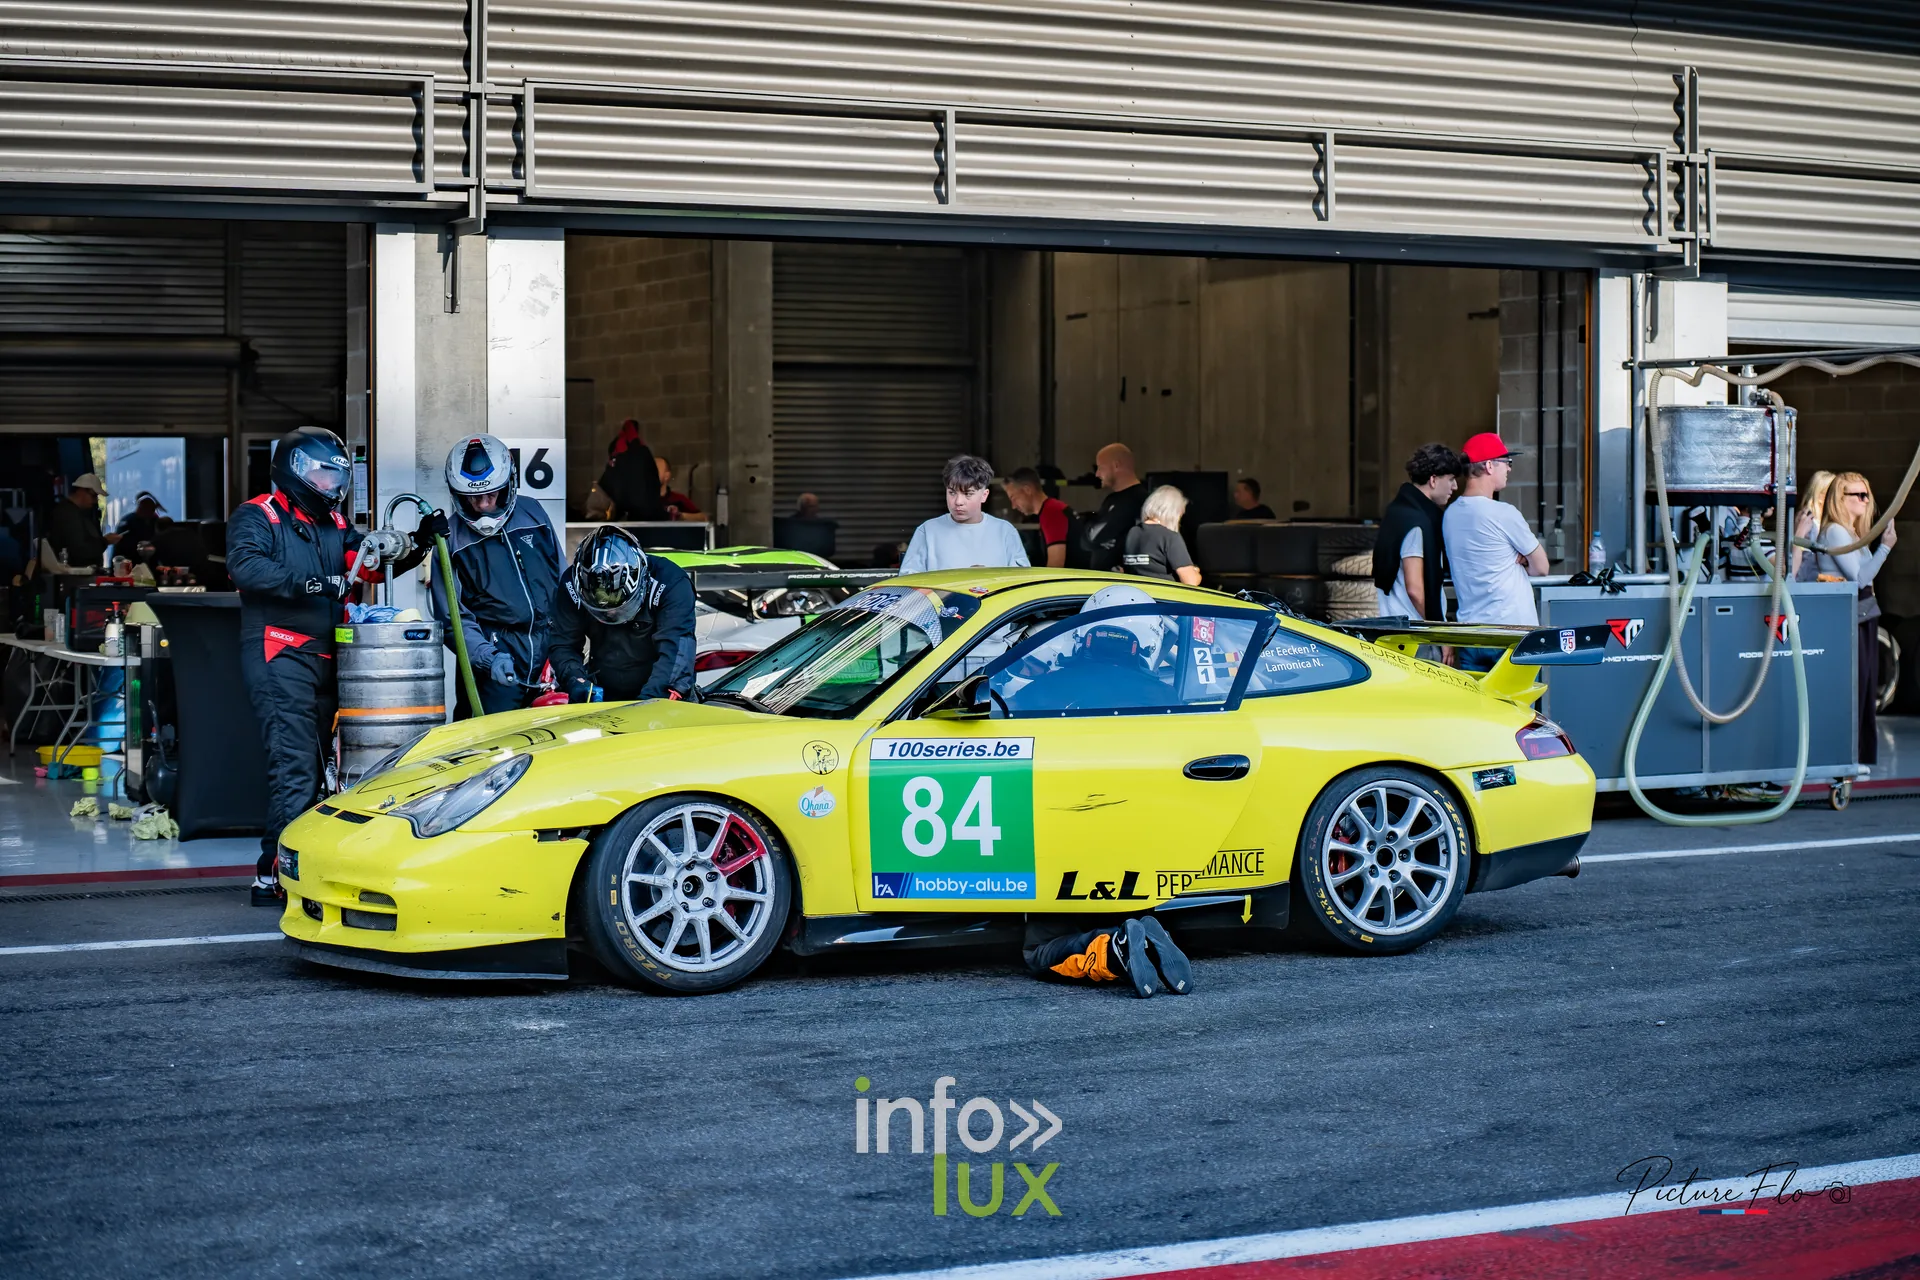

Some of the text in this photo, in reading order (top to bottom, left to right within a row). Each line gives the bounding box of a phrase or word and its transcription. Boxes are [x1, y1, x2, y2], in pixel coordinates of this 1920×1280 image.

[269, 630, 294, 643] sparco
[1197, 649, 1209, 664] 2
[1276, 644, 1310, 657] Eecken
[1311, 643, 1319, 653] P.
[1360, 642, 1410, 667] PURE
[1265, 657, 1324, 673] Lamonica N.
[1200, 667, 1210, 682] 1
[888, 741, 1020, 757] 100series.be
[801, 797, 831, 812] Ohana
[901, 775, 1002, 858] 84
[915, 877, 1028, 895] hobby-alu.be
[1055, 870, 1150, 901] L&L
[615, 921, 672, 981] P ZERO
